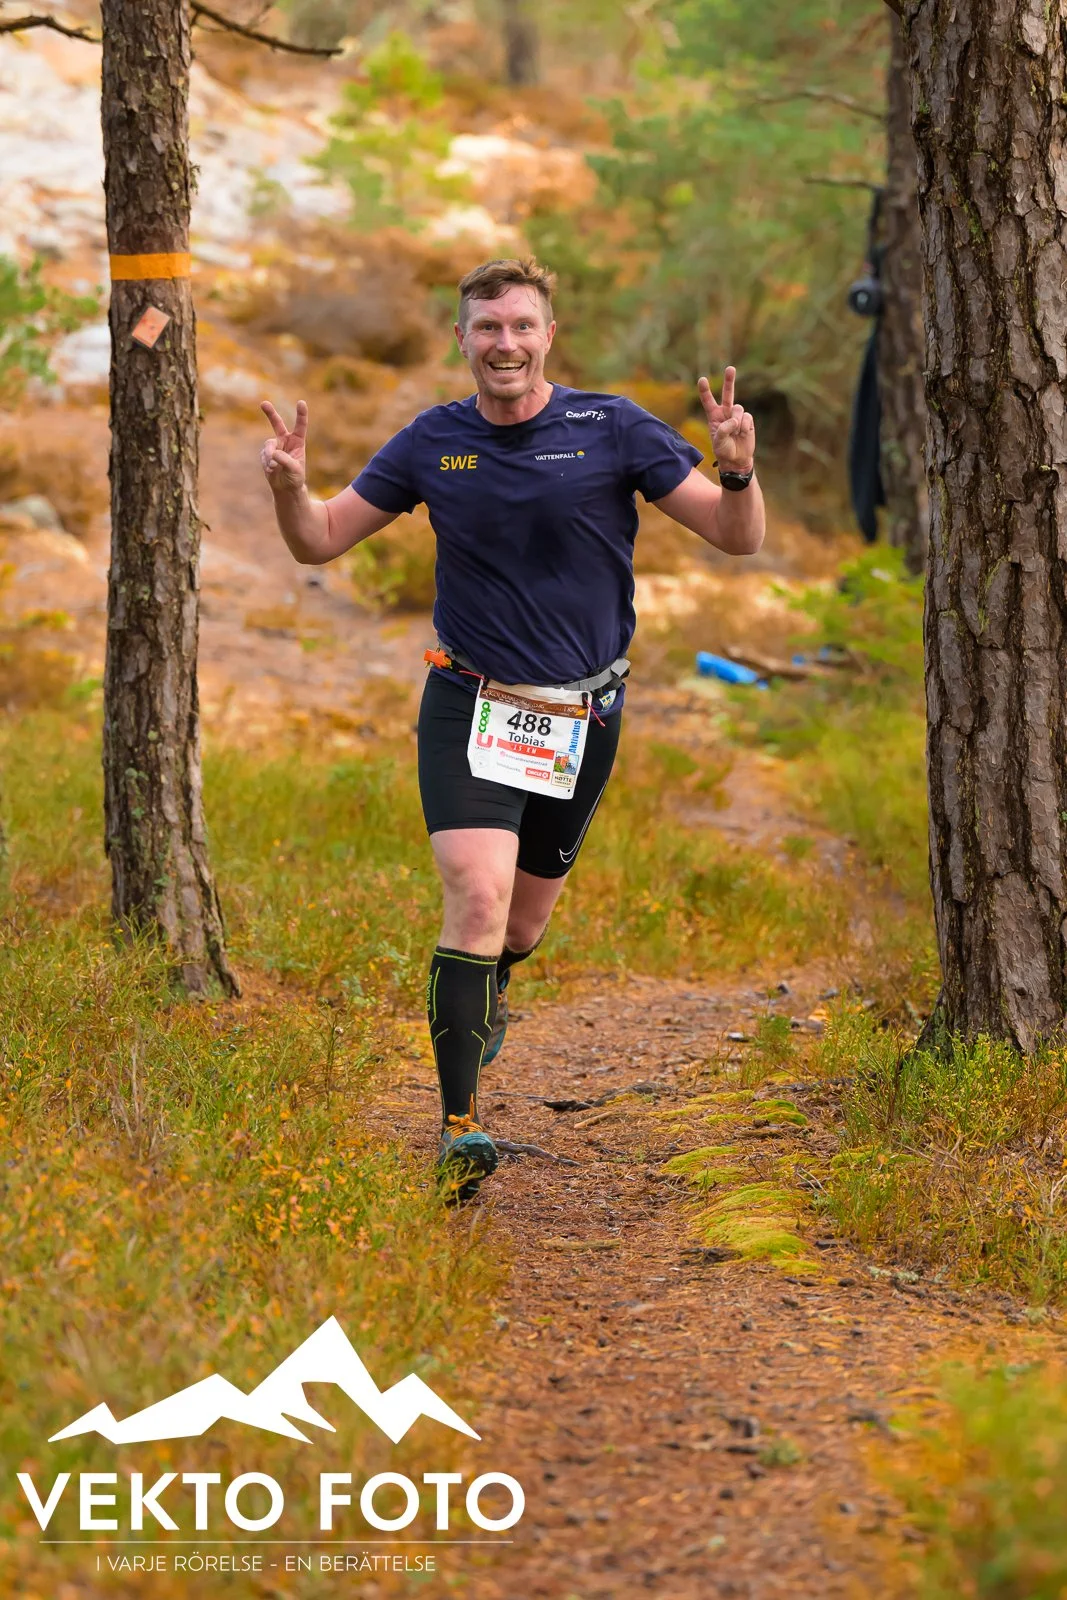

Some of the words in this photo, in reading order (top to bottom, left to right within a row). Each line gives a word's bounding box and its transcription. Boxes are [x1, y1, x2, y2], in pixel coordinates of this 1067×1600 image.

[565, 410, 599, 419] CRAFT
[439, 455, 479, 471] SWE
[535, 452, 576, 461] VATTENFALL
[478, 701, 491, 733] coop
[506, 711, 552, 736] 488
[508, 732, 546, 748] Tobias
